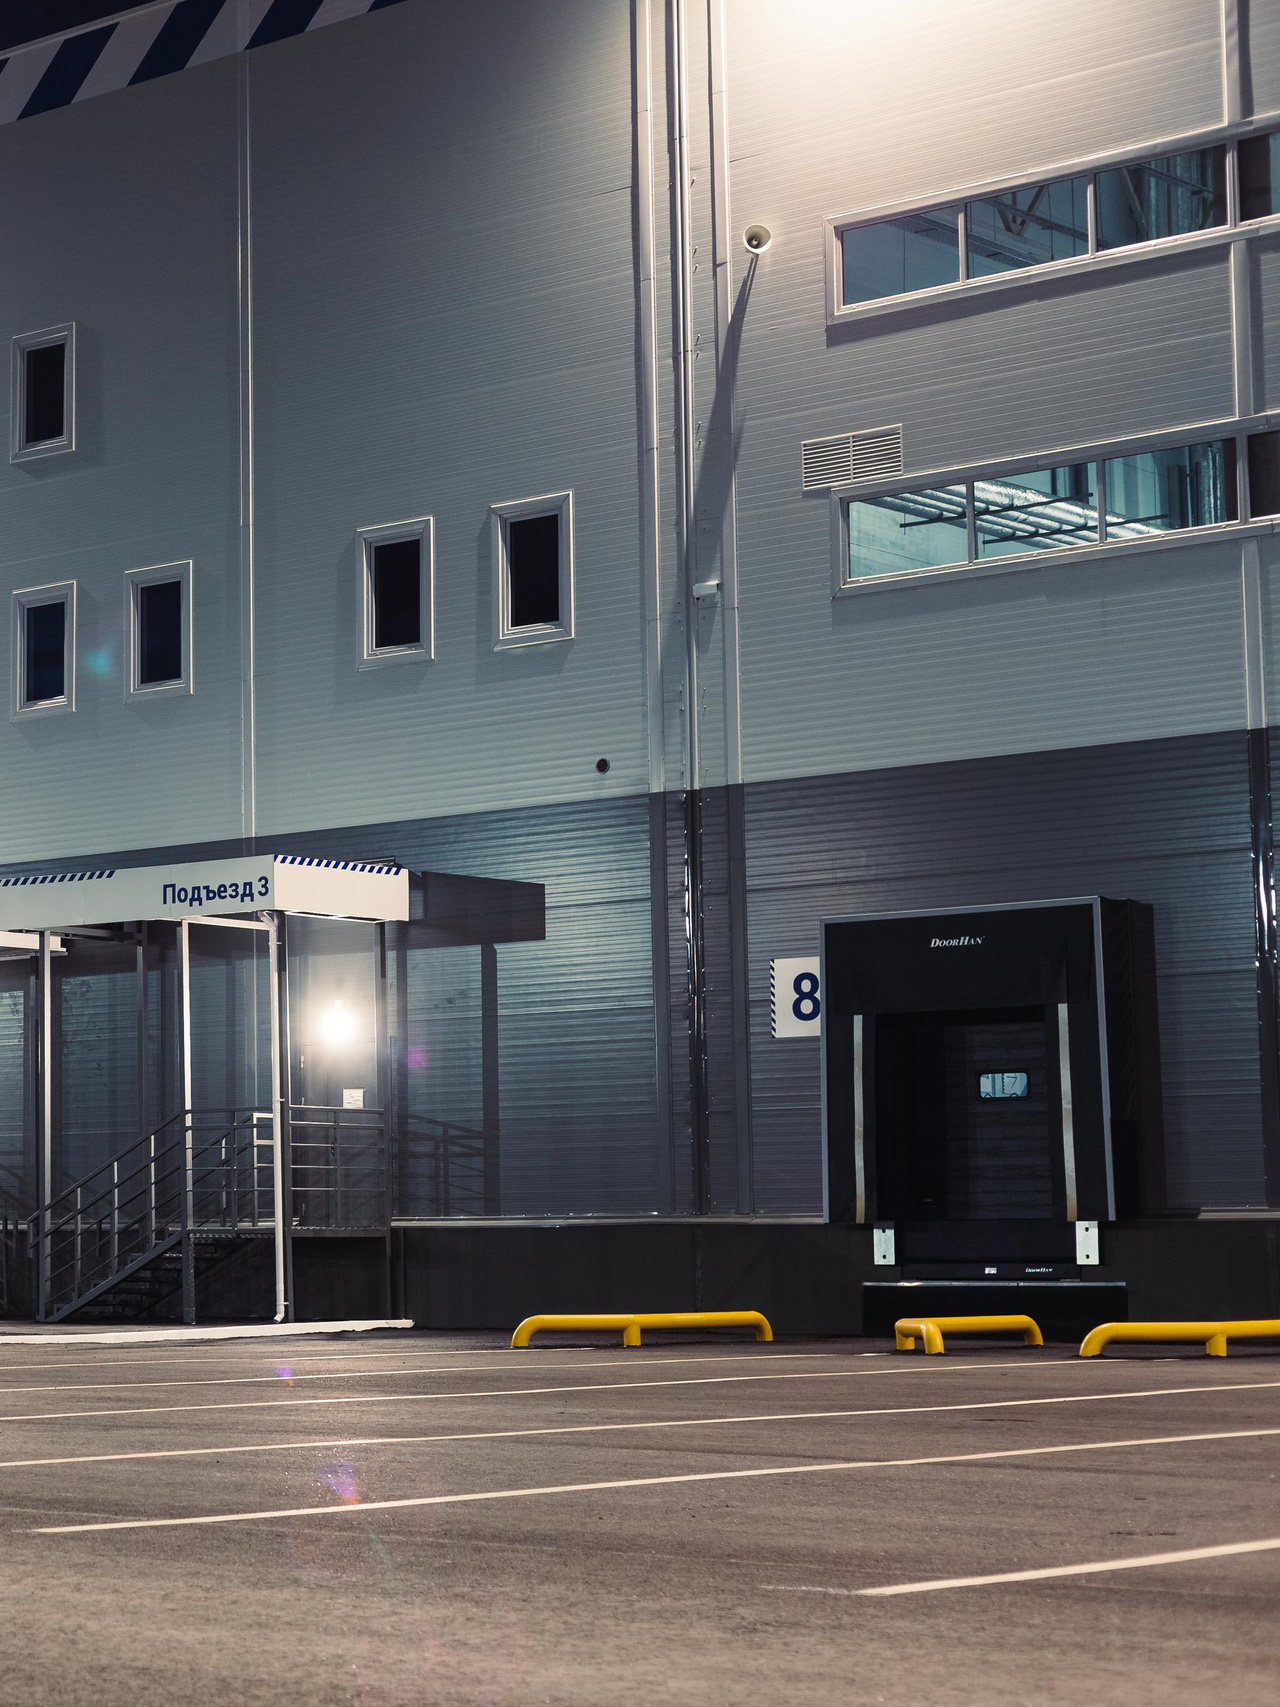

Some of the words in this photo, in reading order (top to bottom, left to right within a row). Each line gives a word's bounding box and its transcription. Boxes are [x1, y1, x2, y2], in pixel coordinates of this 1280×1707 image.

[163, 882, 254, 907] Подъезд
[257, 876, 269, 897] 3
[792, 972, 820, 1022] 8
